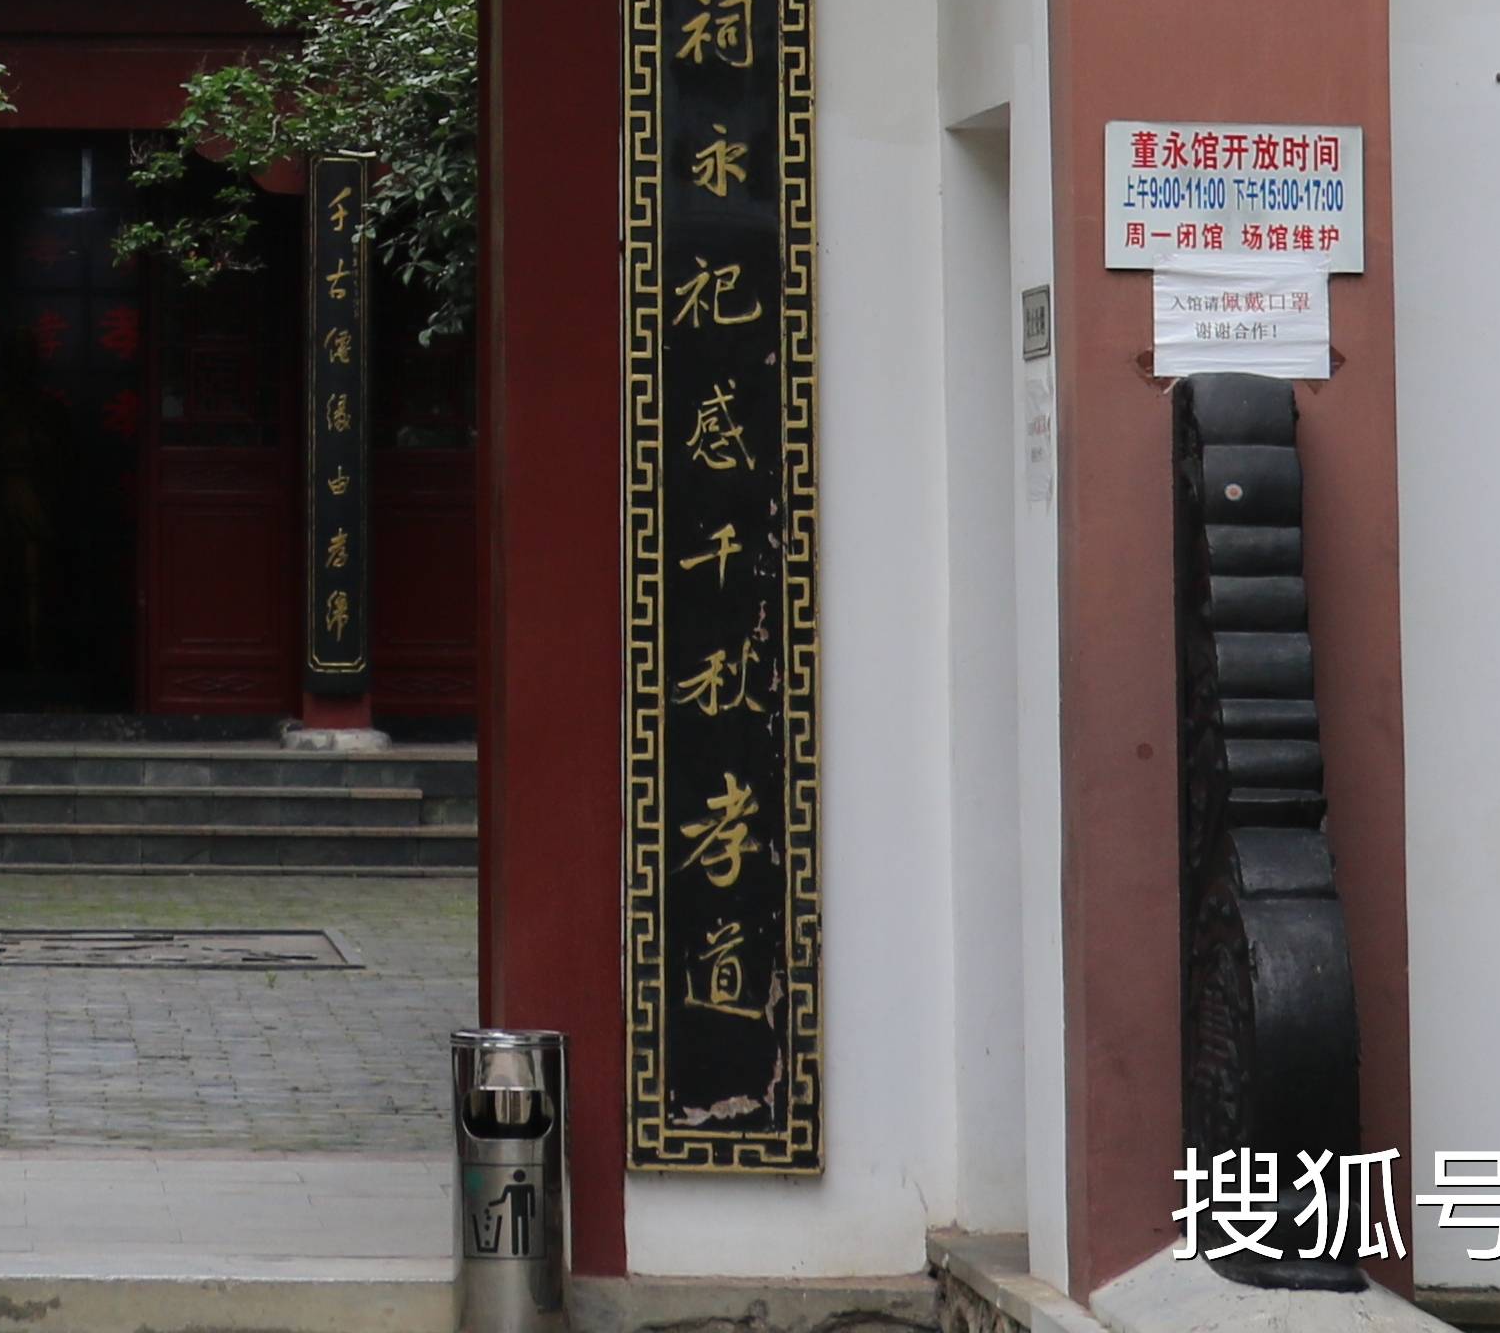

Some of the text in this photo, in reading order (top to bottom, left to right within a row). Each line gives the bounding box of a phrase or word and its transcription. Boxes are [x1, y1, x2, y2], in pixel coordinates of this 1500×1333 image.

[1131, 131, 1339, 172] 董永馆开放时间
[1123, 175, 1344, 211] 上午9:00-11:00 下午15:00-17:00
[1125, 222, 1340, 252] 周一闭馆 场馆维护
[1171, 291, 1311, 314] 入馆请佩戴口罩
